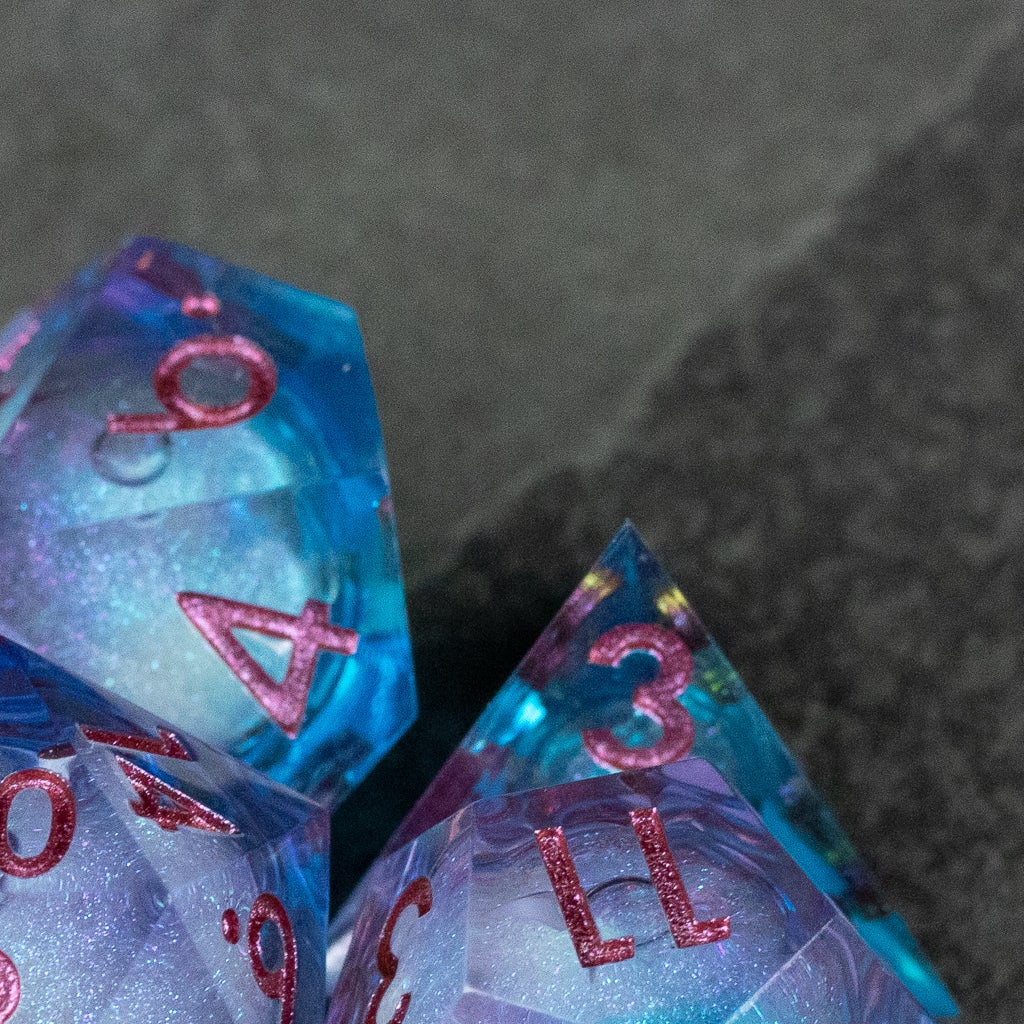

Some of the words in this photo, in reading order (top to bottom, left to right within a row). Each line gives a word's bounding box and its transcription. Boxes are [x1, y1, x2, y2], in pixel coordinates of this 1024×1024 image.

[175, 590, 360, 740] 4
[585, 622, 696, 770] 3
[533, 806, 732, 968] 11
